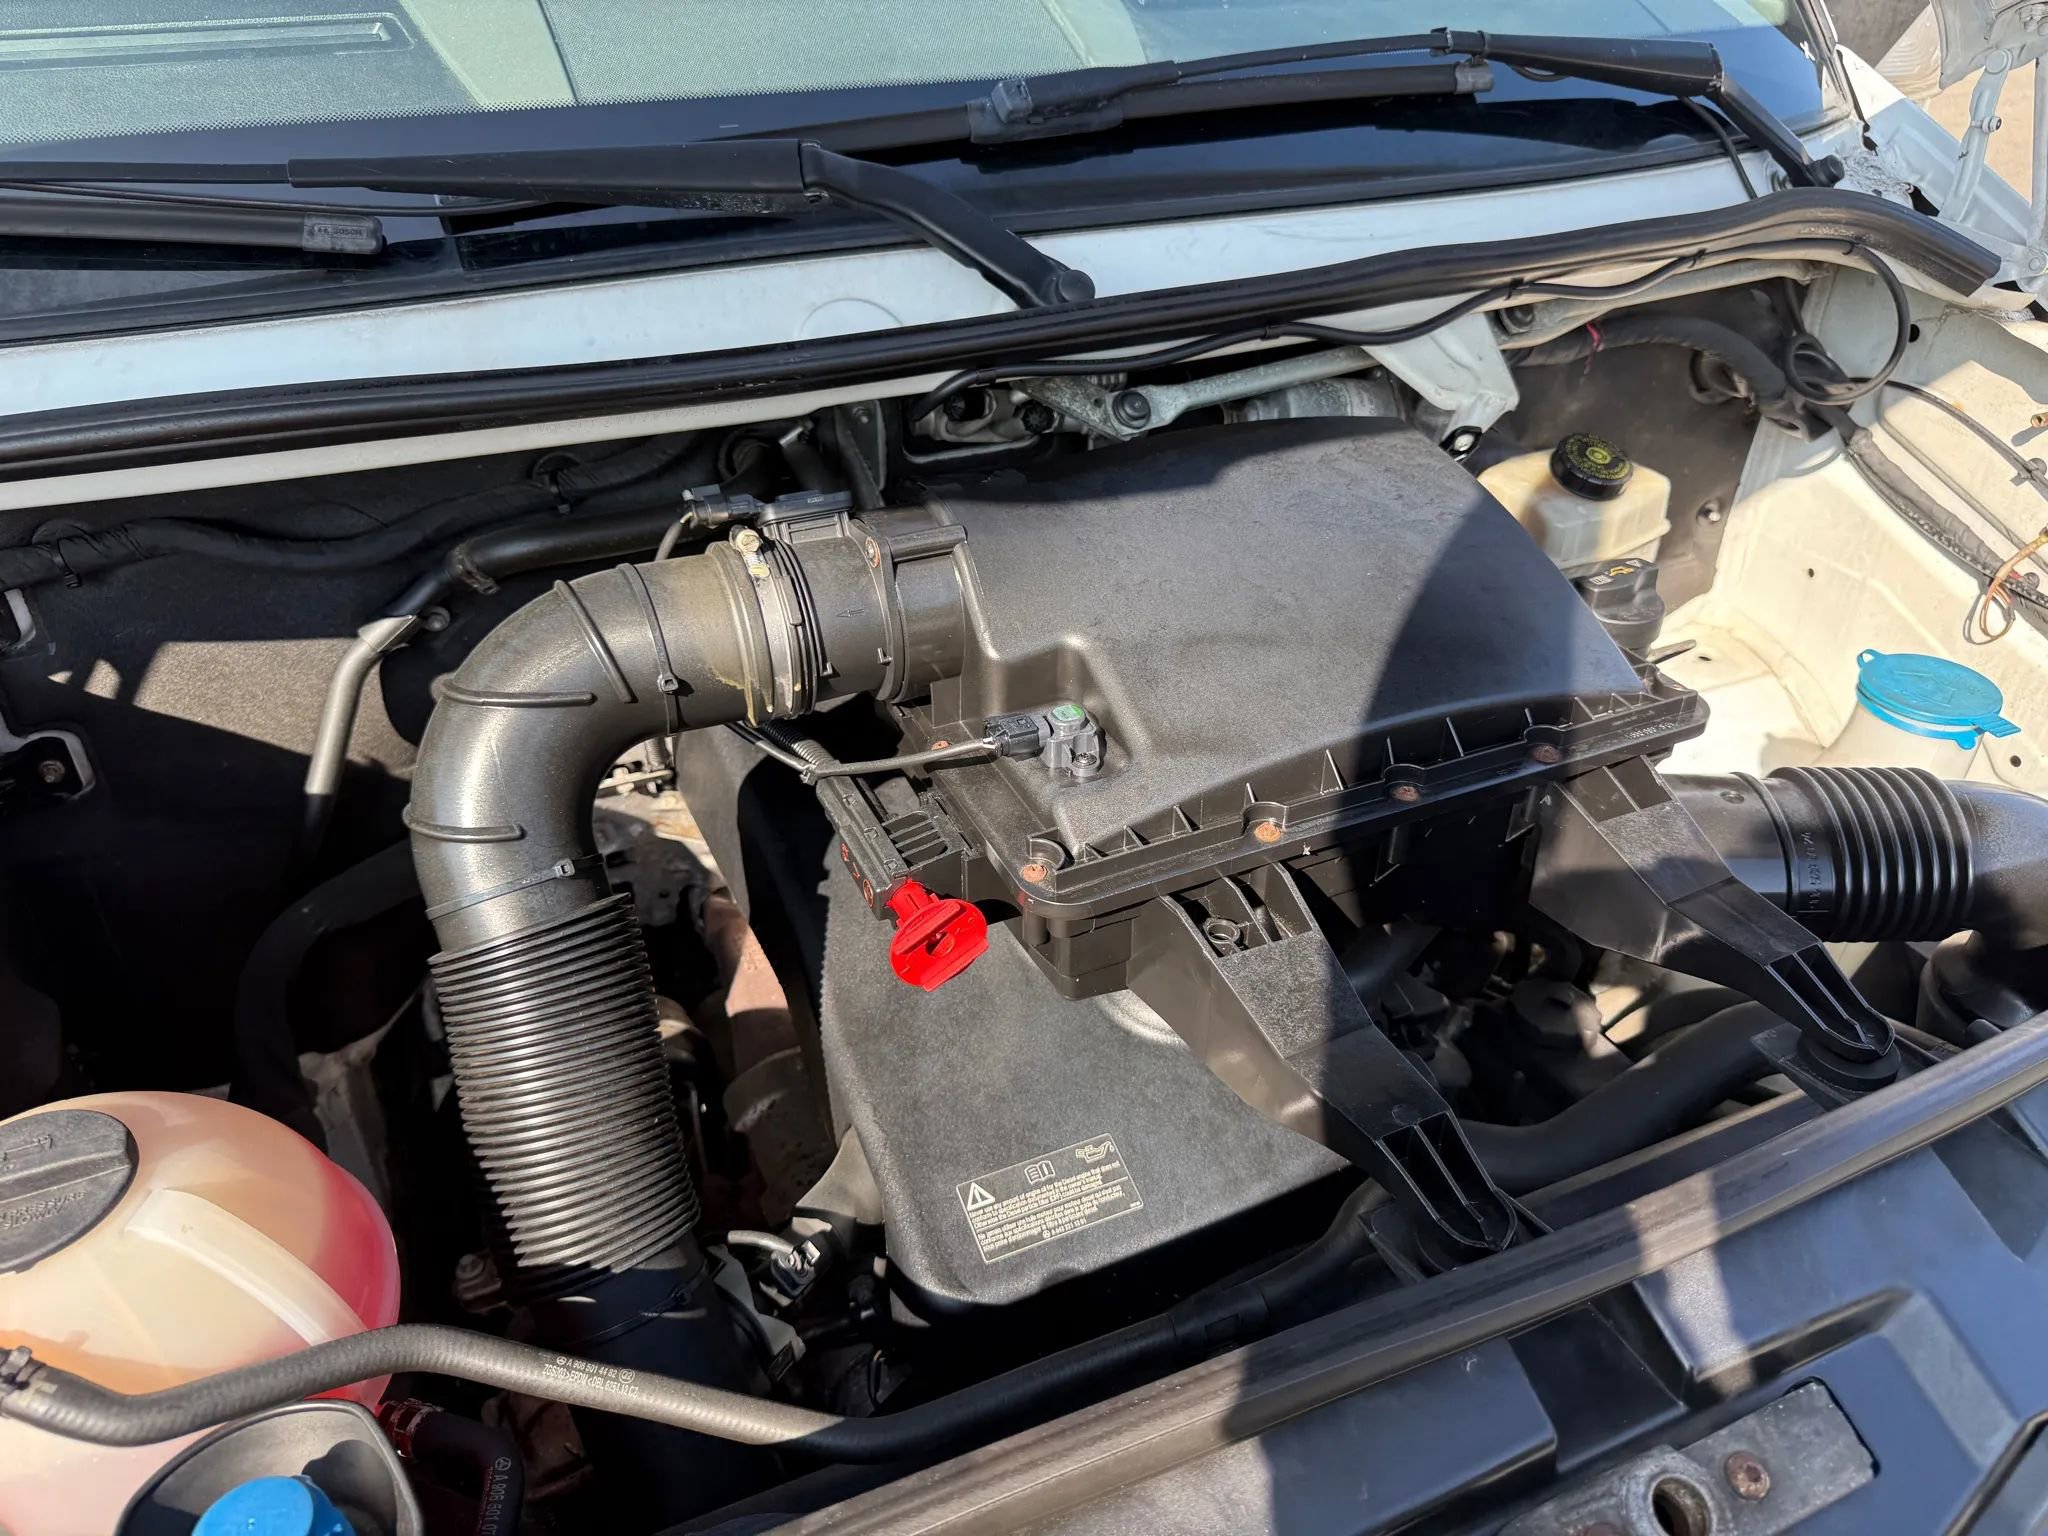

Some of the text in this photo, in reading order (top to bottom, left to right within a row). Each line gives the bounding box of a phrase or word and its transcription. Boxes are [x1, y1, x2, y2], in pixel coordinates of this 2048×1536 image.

[566, 1359, 572, 1367] A
[585, 1363, 598, 1374] 501
[599, 1366, 608, 1376] 44
[608, 1368, 617, 1378] 82
